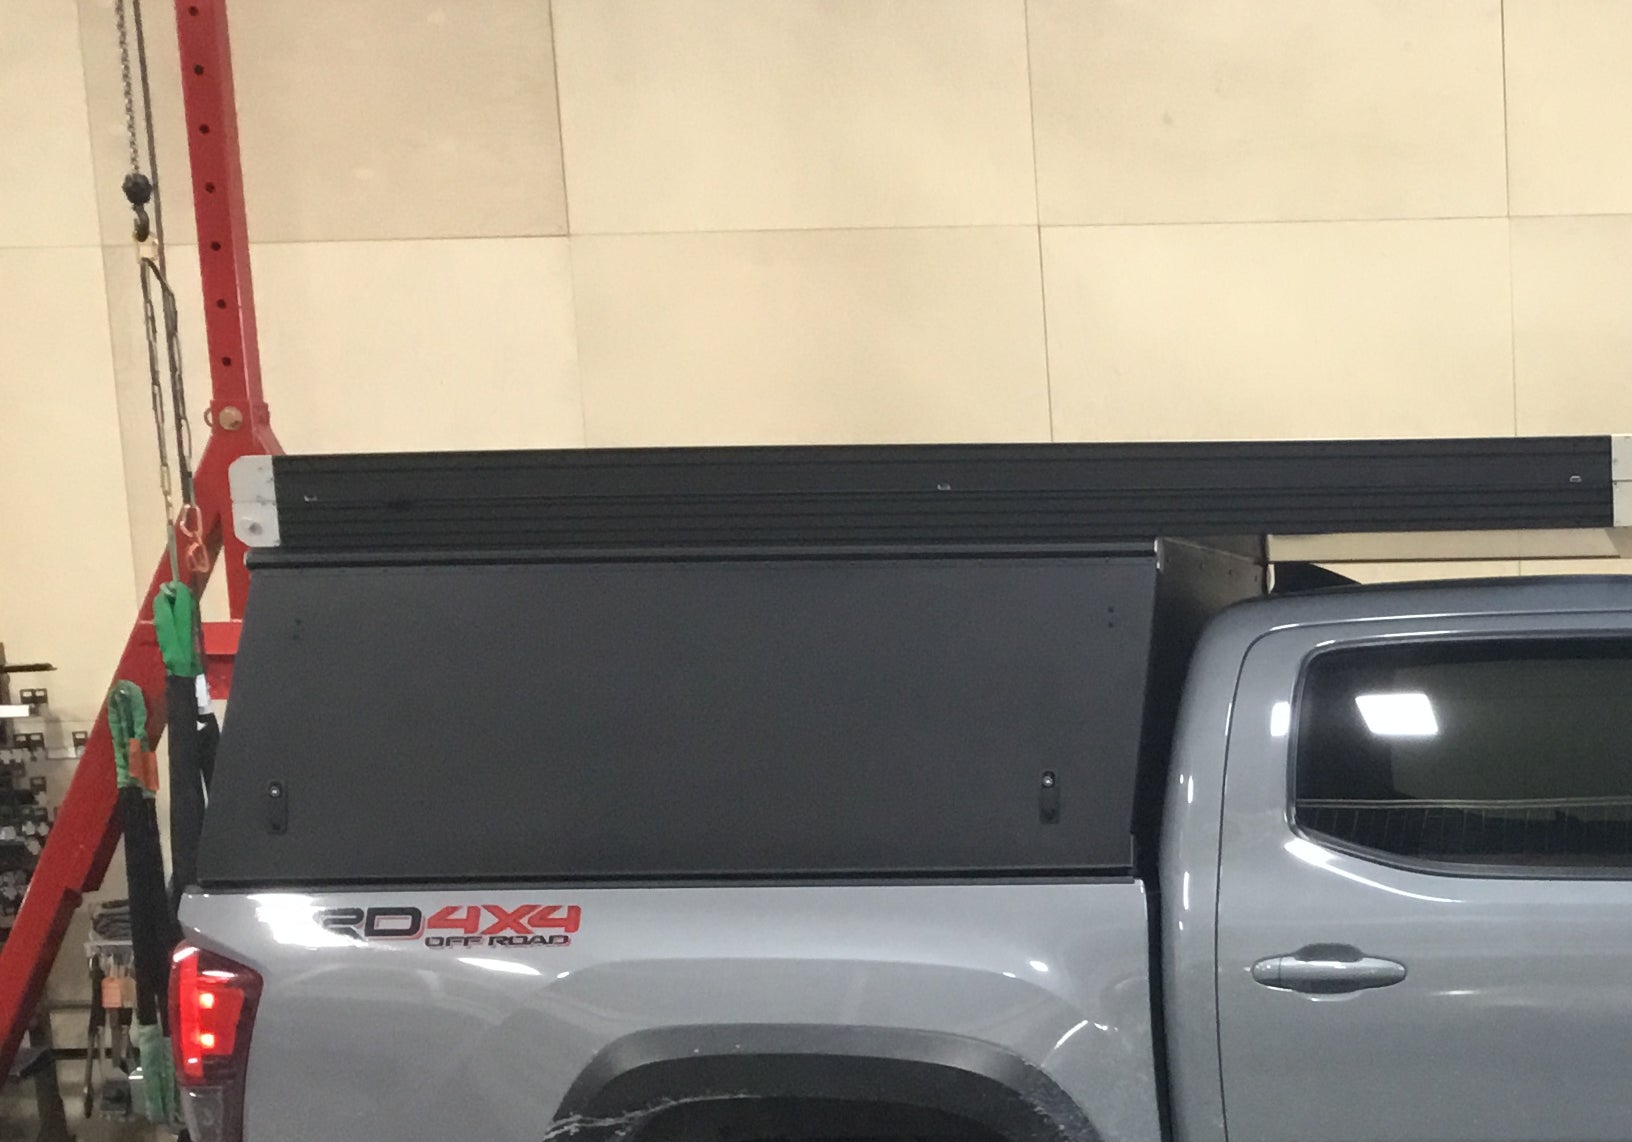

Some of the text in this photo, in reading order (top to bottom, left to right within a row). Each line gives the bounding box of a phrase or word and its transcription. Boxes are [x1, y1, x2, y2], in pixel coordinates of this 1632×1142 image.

[313, 907, 425, 941] RD
[424, 934, 571, 948] OFF ROAD
